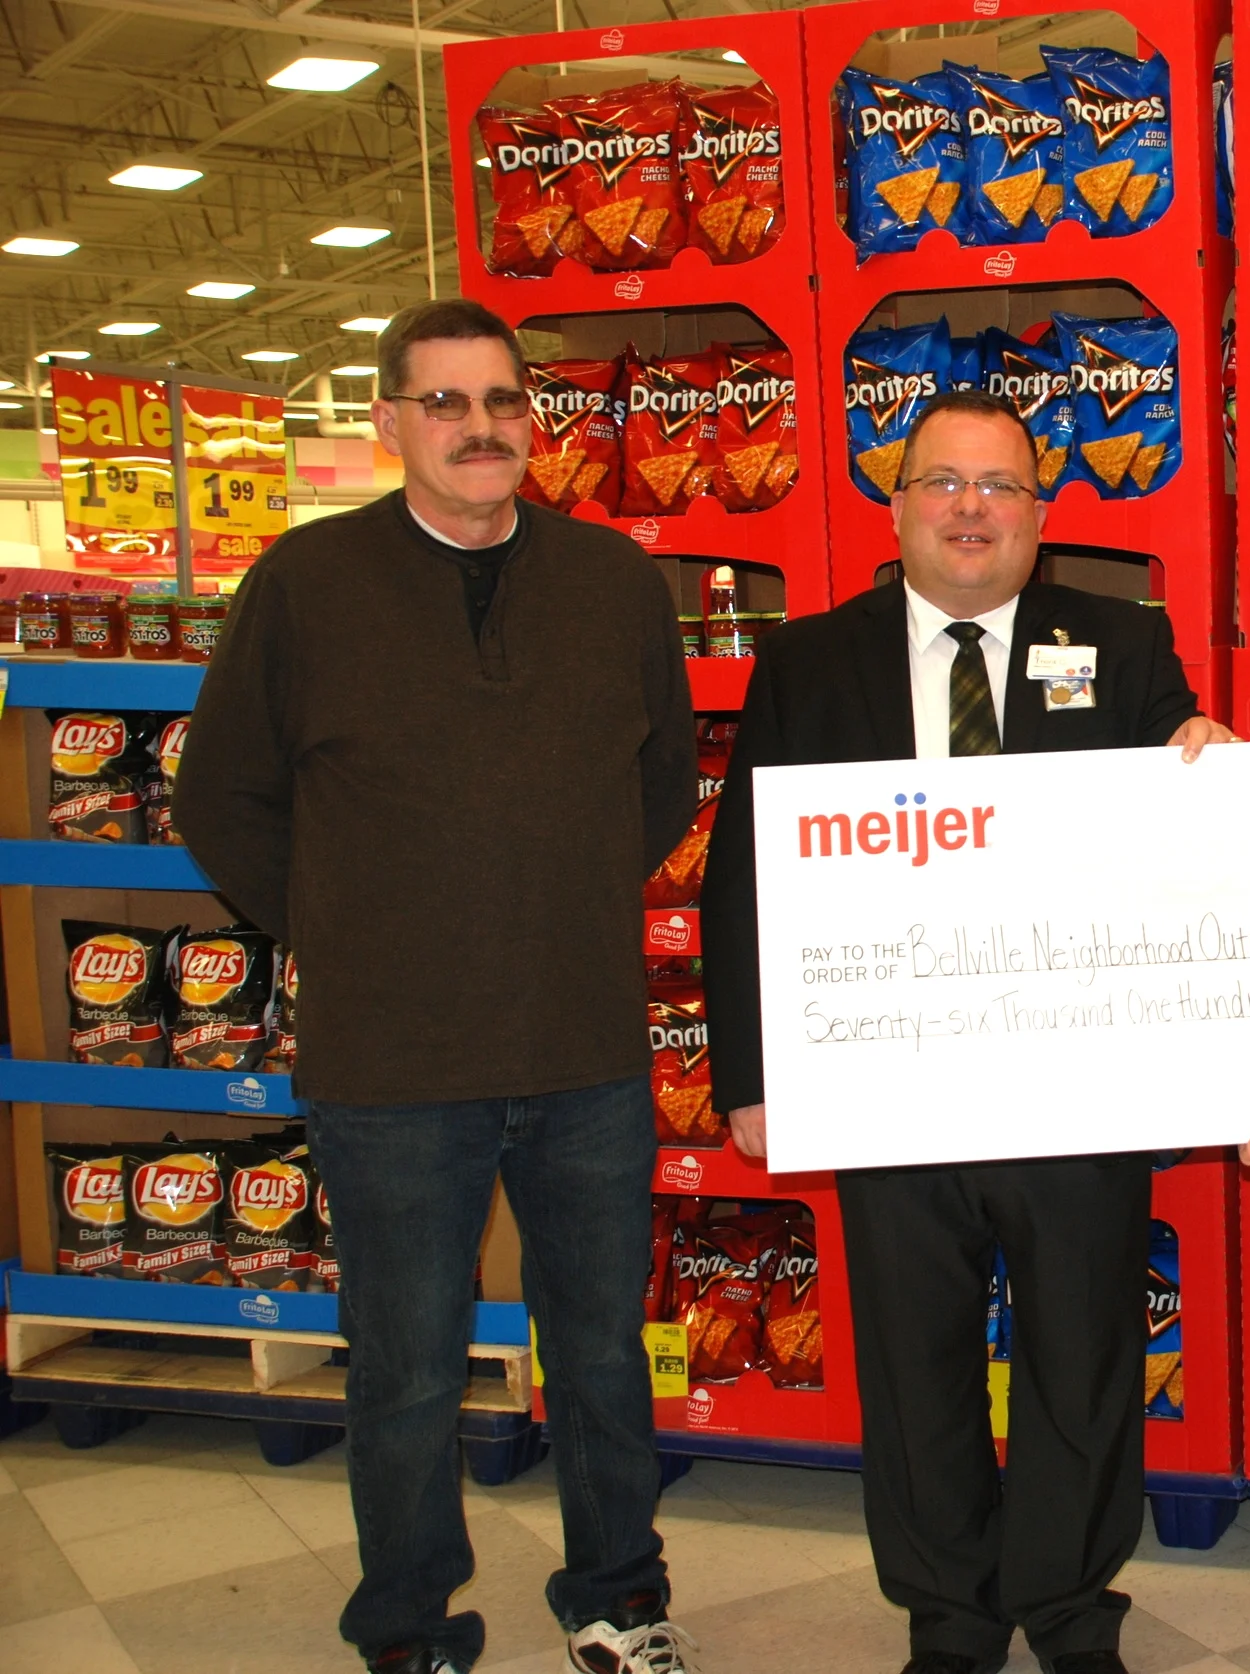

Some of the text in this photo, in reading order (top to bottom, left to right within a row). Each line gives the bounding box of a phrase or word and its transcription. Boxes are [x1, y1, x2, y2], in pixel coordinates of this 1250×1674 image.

[861, 105, 960, 136] Doritos
[1065, 97, 1165, 124] Doritos
[969, 108, 1065, 136] Dorito
[682, 130, 779, 160] Doritos
[1138, 138, 1167, 148] RANCH
[1145, 131, 1167, 140] COOL
[564, 133, 671, 164] Doritos
[640, 174, 671, 182] CHEESE
[641, 166, 670, 175] NACHO
[746, 173, 779, 182] CHEESE
[748, 165, 779, 174] NACHO
[1071, 364, 1174, 393] Doritos
[846, 372, 937, 408] Doritos
[58, 386, 172, 447] sale
[1146, 410, 1175, 420] RANCH
[586, 430, 615, 439] CHEESE
[589, 423, 615, 432] NACHO
[218, 535, 262, 557] sale
[52, 717, 124, 755] Lay's
[54, 779, 109, 793] Barbecue
[798, 792, 995, 867] meijer
[653, 926, 687, 943] FritoLay
[802, 942, 906, 963] PAY TO THE
[906, 923, 1025, 979] Bellville
[1032, 920, 1193, 988] Neighborhood
[75, 947, 143, 988] Lay's
[803, 964, 899, 985] ORDER OF
[992, 989, 1113, 1034] Thousand
[1127, 988, 1173, 1025] One
[104, 1023, 131, 1042] Size!
[230, 1086, 263, 1100] FritoLay
[666, 1165, 699, 1181] FritoLay
[141, 1169, 217, 1206] Lay's
[239, 1171, 298, 1210] Lay's
[147, 1228, 209, 1241] Barbecue
[236, 1231, 288, 1248] Barbecue
[137, 1242, 212, 1270] Family Size!
[228, 1251, 290, 1271] Family Size!
[679, 1252, 757, 1280] Doritos
[724, 1286, 752, 1296] NACHO
[243, 1303, 276, 1316] FritoLay
[655, 1345, 670, 1353] 4.29
[660, 1363, 683, 1373] 1.29
